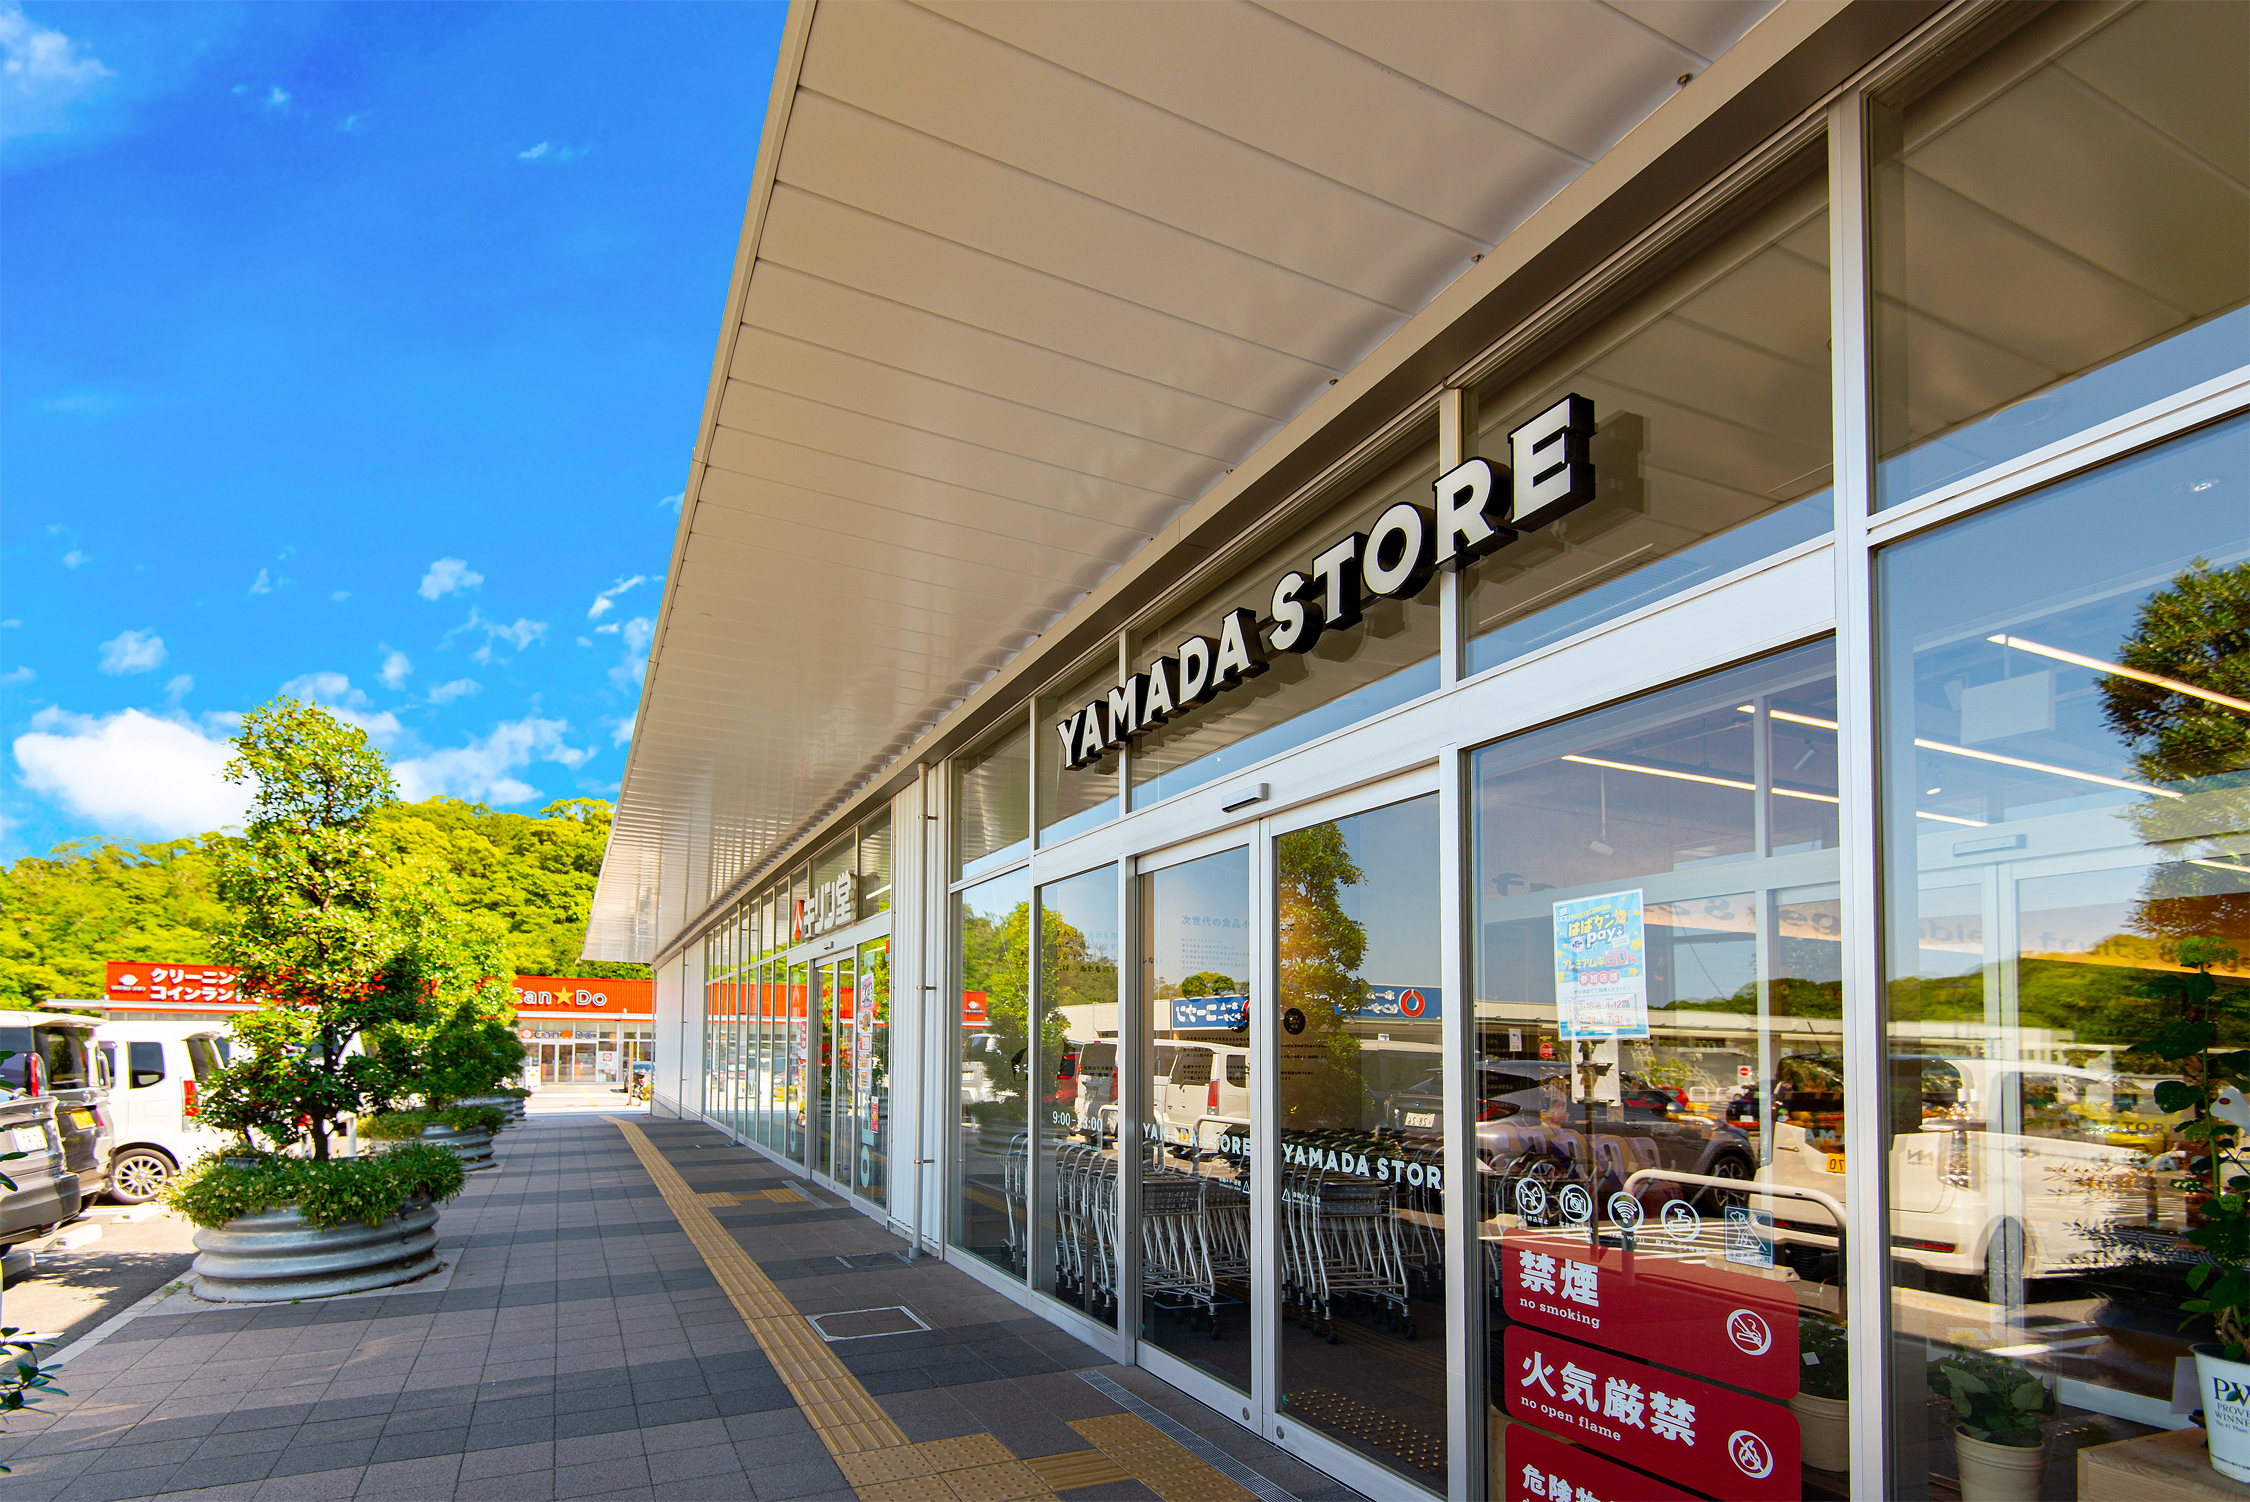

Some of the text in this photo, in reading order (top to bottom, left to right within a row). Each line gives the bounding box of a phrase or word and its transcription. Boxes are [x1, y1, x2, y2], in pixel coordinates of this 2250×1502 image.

[1056, 394, 1580, 769] YAMADA STORE
[803, 869, 854, 938] キリン堂
[1568, 914, 1615, 937] はばタン
[575, 989, 607, 1006] Do
[1143, 1123, 1250, 1157] YAMADA STORE
[1281, 1143, 1371, 1177] YAMADA
[1519, 1249, 1600, 1307] 禁煙
[1519, 1297, 1600, 1329] no smoking
[1521, 1351, 1696, 1447] 火気厳禁
[1521, 1396, 1622, 1441] no open flame
